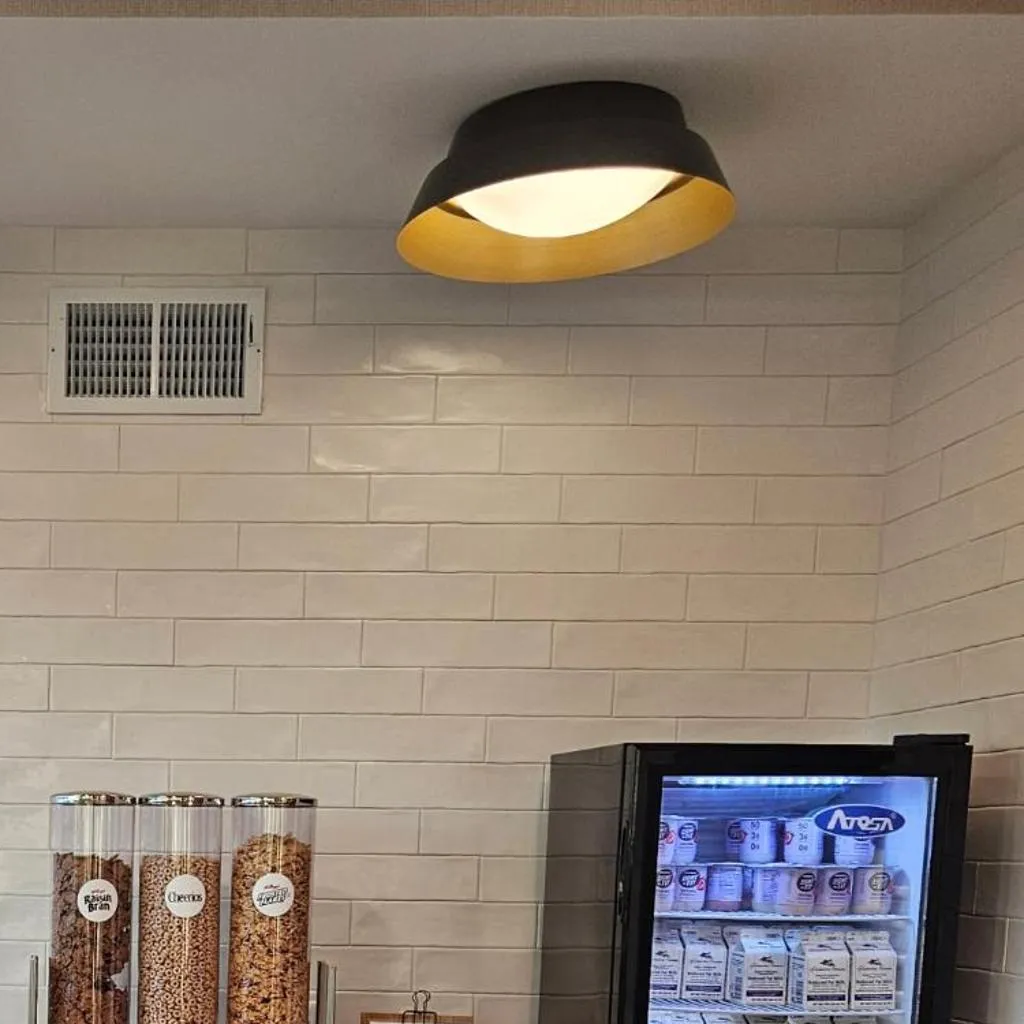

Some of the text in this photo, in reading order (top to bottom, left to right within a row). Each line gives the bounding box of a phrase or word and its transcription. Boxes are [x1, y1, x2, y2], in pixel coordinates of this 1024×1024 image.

[84, 894, 112, 904] Raisin
[168, 892, 203, 903] Cheerios
[88, 903, 110, 912] Bran
